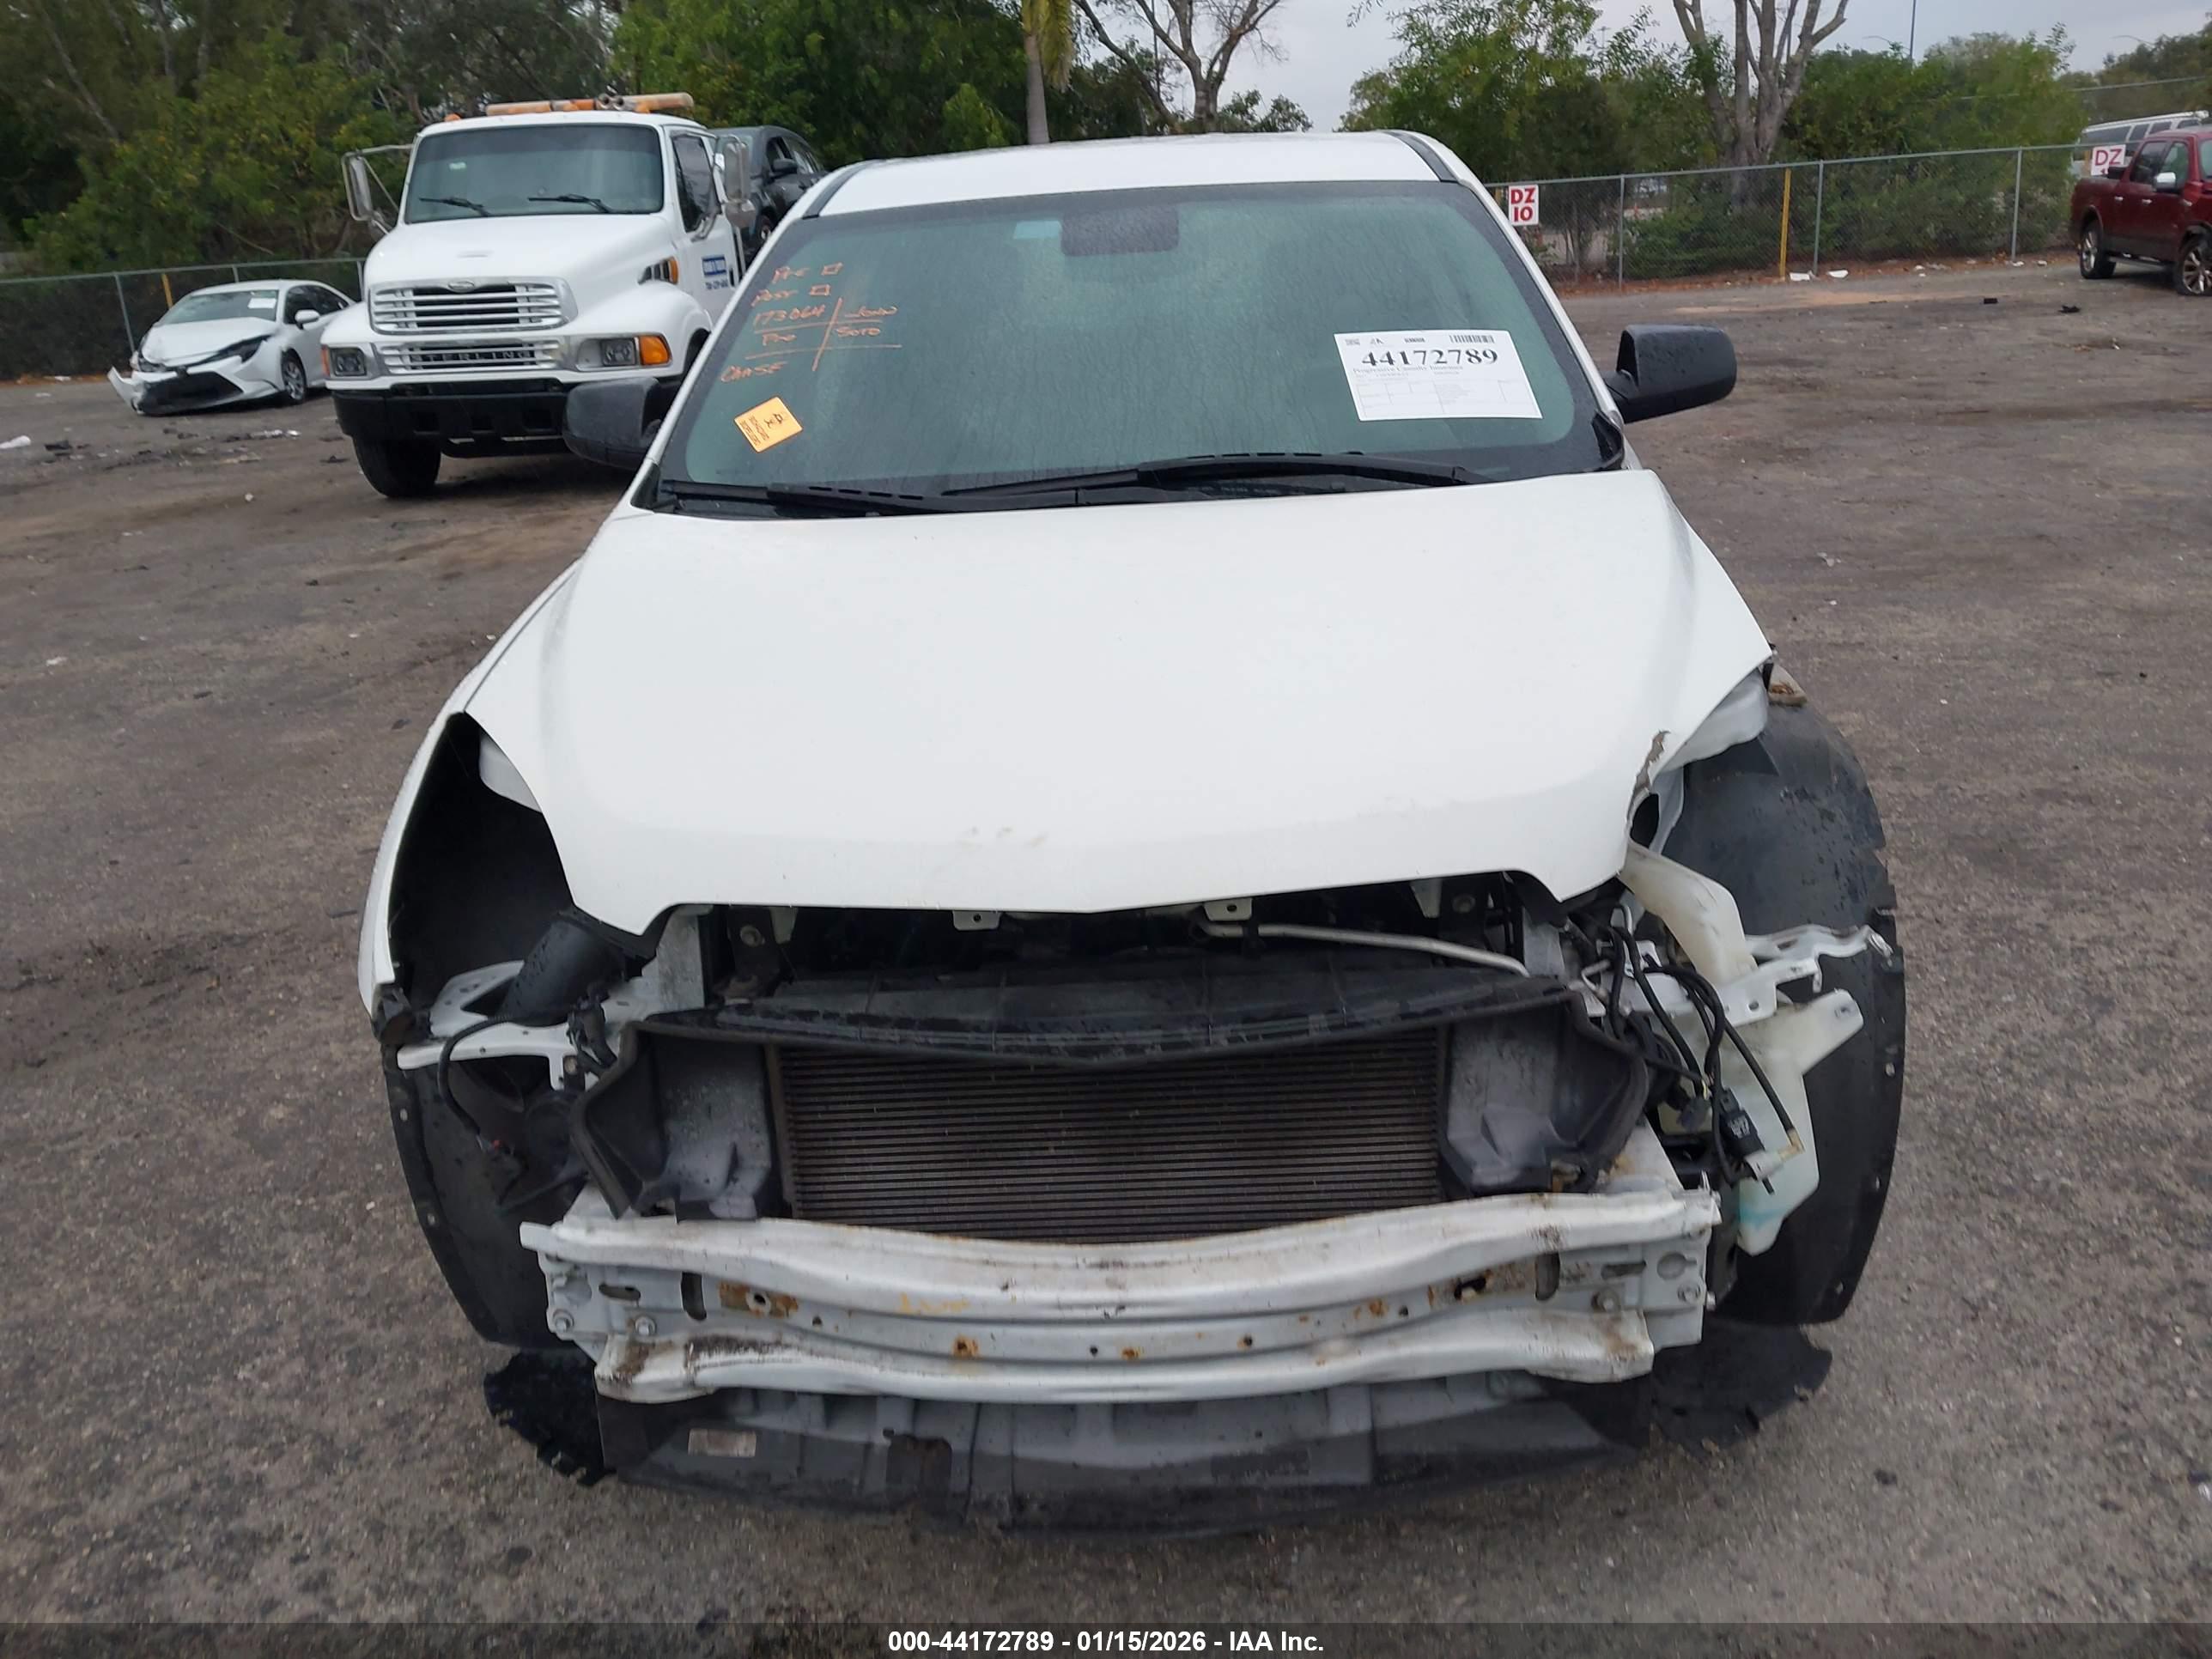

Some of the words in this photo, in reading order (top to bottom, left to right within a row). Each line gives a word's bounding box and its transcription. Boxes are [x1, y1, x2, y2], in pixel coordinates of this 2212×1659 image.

[2095, 149, 2122, 166] DZ
[1511, 188, 1534, 204] DZ
[1515, 207, 1533, 222] 10
[1361, 349, 1498, 367] 44172789
